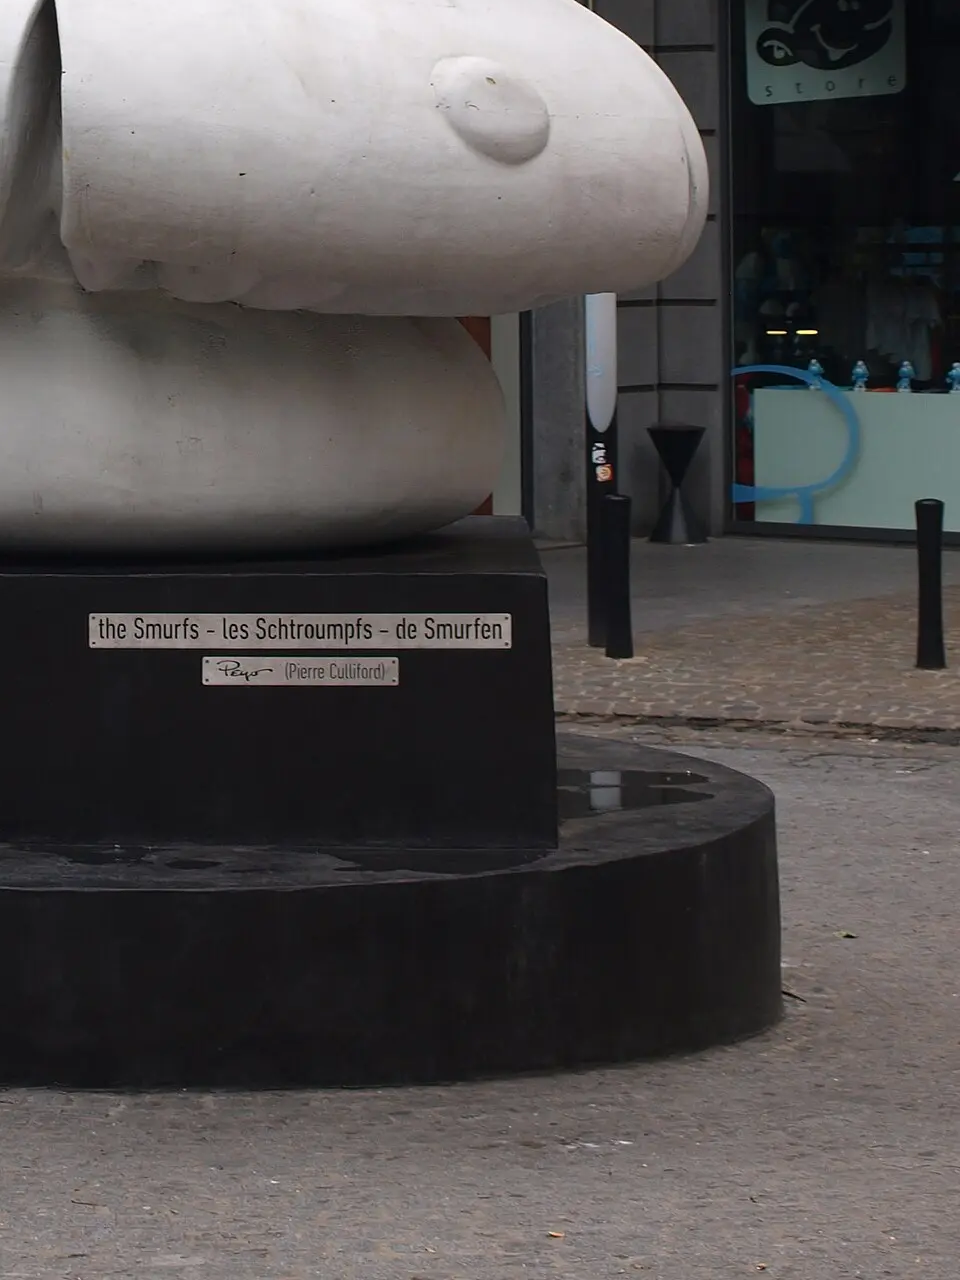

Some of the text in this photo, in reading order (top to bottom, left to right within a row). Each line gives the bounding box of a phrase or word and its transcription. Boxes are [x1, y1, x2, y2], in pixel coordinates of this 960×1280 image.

[764, 74, 897, 97] store
[98, 618, 127, 640] the
[134, 618, 199, 640] Smurfs
[222, 618, 249, 640] les
[256, 618, 373, 645] Schtroumpfs
[396, 618, 417, 640] de
[424, 618, 503, 640] Smurfen
[285, 663, 325, 680] (Pierre
[329, 663, 385, 680] Culliford)
